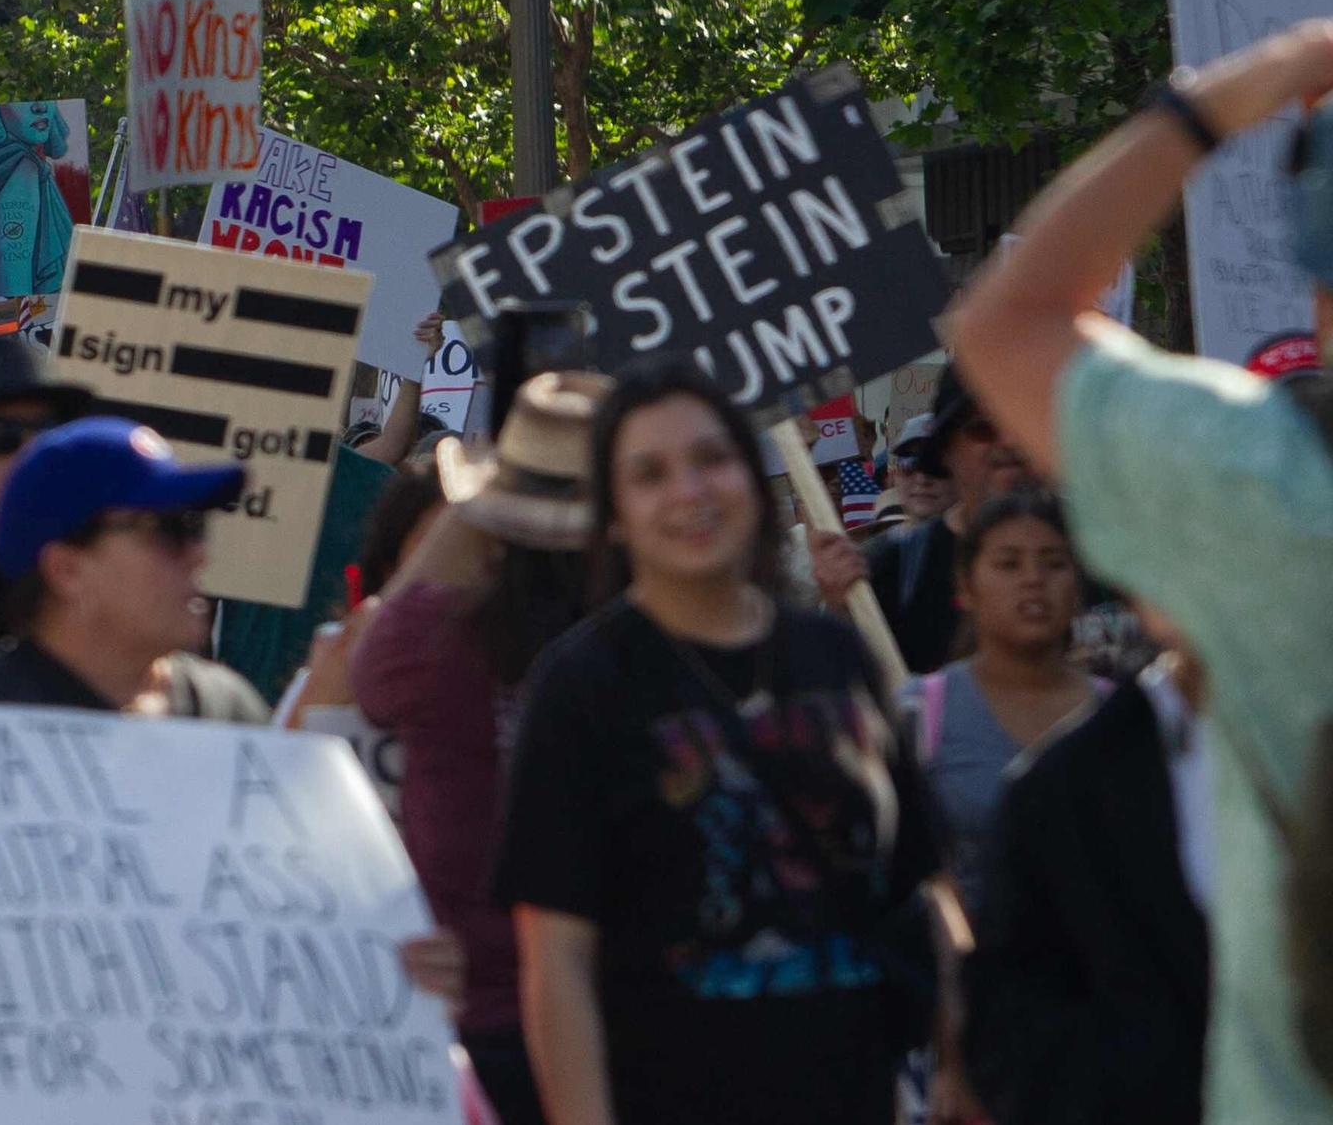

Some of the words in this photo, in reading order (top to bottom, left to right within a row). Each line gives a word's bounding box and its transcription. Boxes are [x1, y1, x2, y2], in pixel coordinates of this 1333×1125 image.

[135, 0, 175, 81] NO
[455, 95, 822, 321] EPSTEIN
[165, 283, 228, 321] my
[81, 332, 164, 377] sign
[234, 426, 298, 460] got
[231, 741, 306, 837] A
[202, 841, 339, 925] ASS
[183, 923, 415, 1031] STAND
[146, 1020, 450, 1111] SOMETHING
